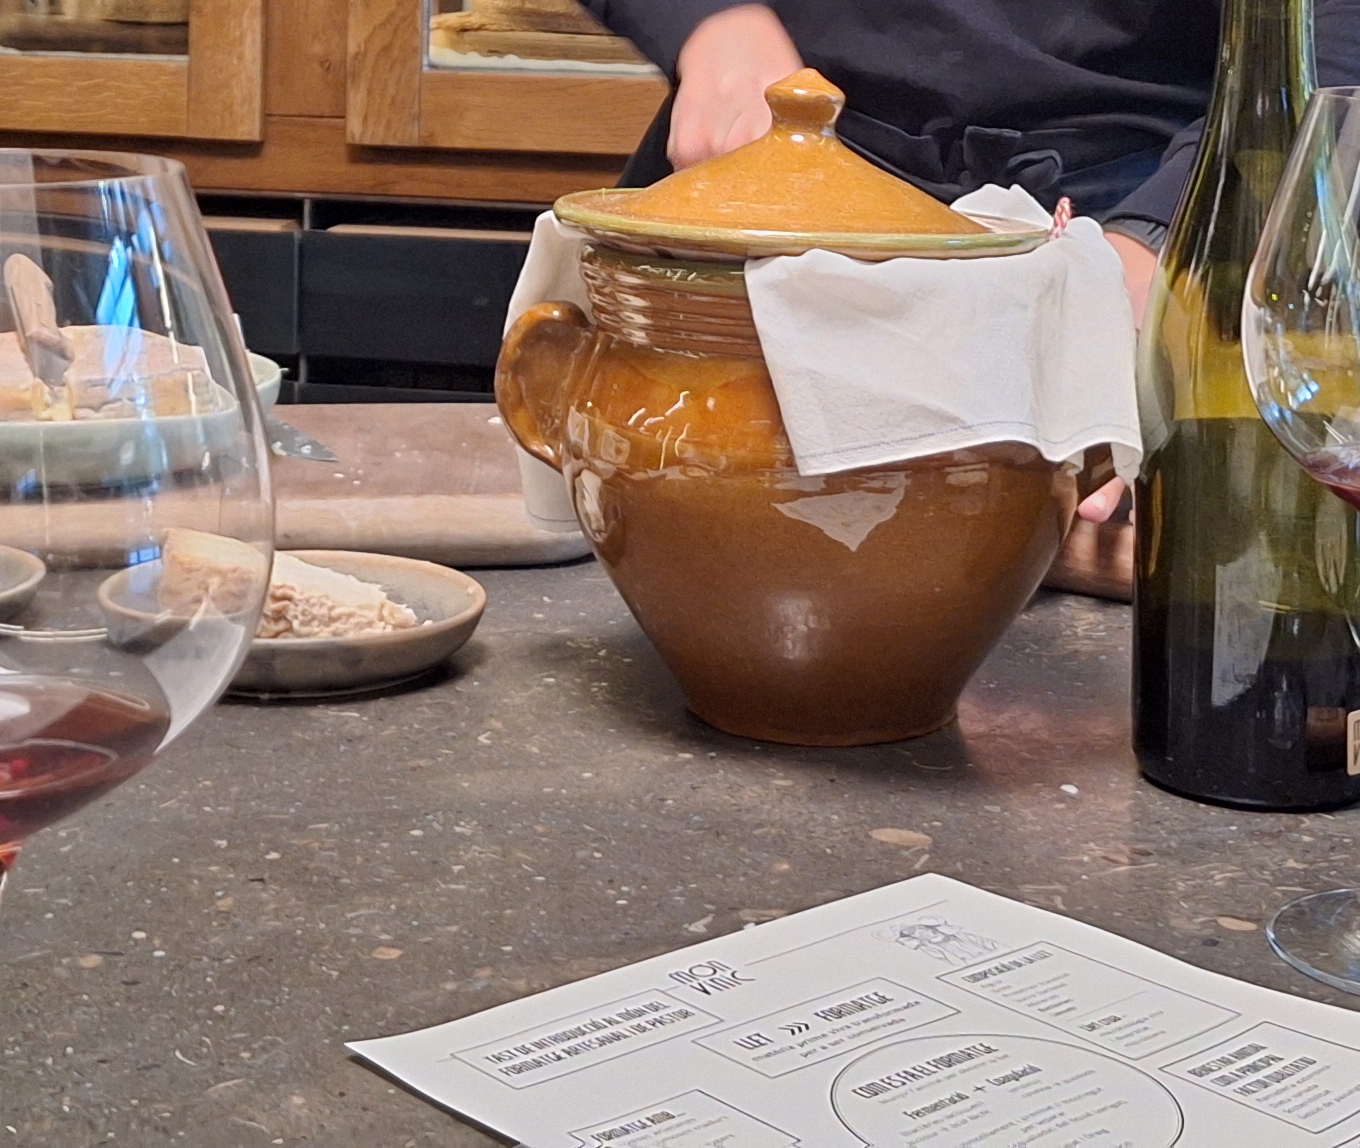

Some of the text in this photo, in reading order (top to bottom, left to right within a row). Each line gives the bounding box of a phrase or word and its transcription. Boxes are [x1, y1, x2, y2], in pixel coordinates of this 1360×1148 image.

[813, 991, 896, 1023] FORMATGE
[483, 1048, 518, 1065] TAST
[514, 1043, 534, 1056] DE
[531, 1018, 609, 1052] INTRODUCCIÓ
[601, 1015, 624, 1027] AL
[498, 1051, 564, 1078] FORMATGE
[560, 1029, 634, 1059] ARTESANAL
[647, 1008, 696, 1029] PASTOR
[926, 1042, 1001, 1073] FORMATGE
